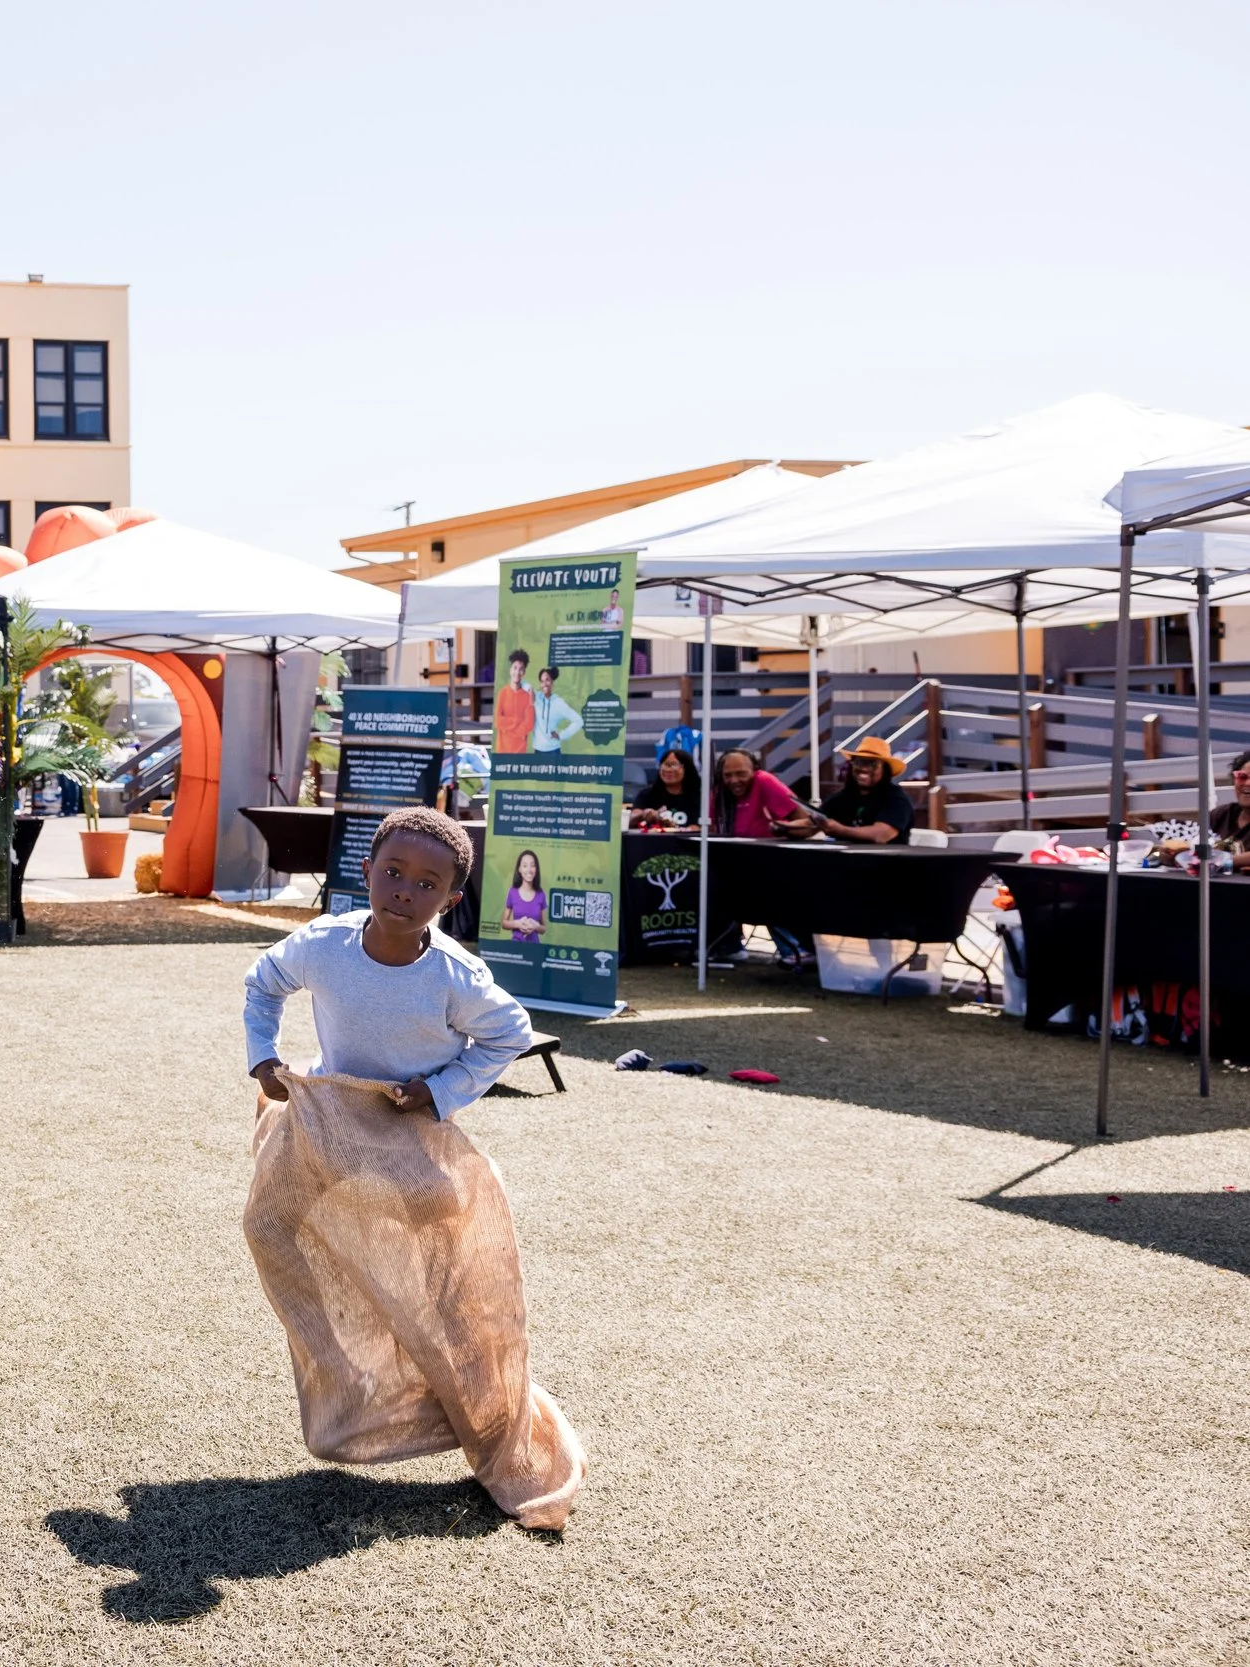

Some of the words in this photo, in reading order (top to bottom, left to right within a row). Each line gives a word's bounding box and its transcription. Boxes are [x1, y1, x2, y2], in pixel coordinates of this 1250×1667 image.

[516, 571, 570, 588] ELEVATE
[574, 567, 617, 584] YOUTH
[373, 713, 439, 725] NEIGHBORHOOD
[354, 721, 377, 731] PEACE
[378, 722, 429, 734] COMMITTEES
[552, 795, 574, 804] Project
[562, 806, 585, 814] impact
[520, 815, 536, 824] Drugs
[513, 826, 551, 834] communities
[557, 876, 582, 884] APPLY
[584, 876, 604, 884] NOW
[564, 895, 586, 906] SCAN
[564, 906, 584, 919] ME!
[640, 911, 696, 931] ROOTS
